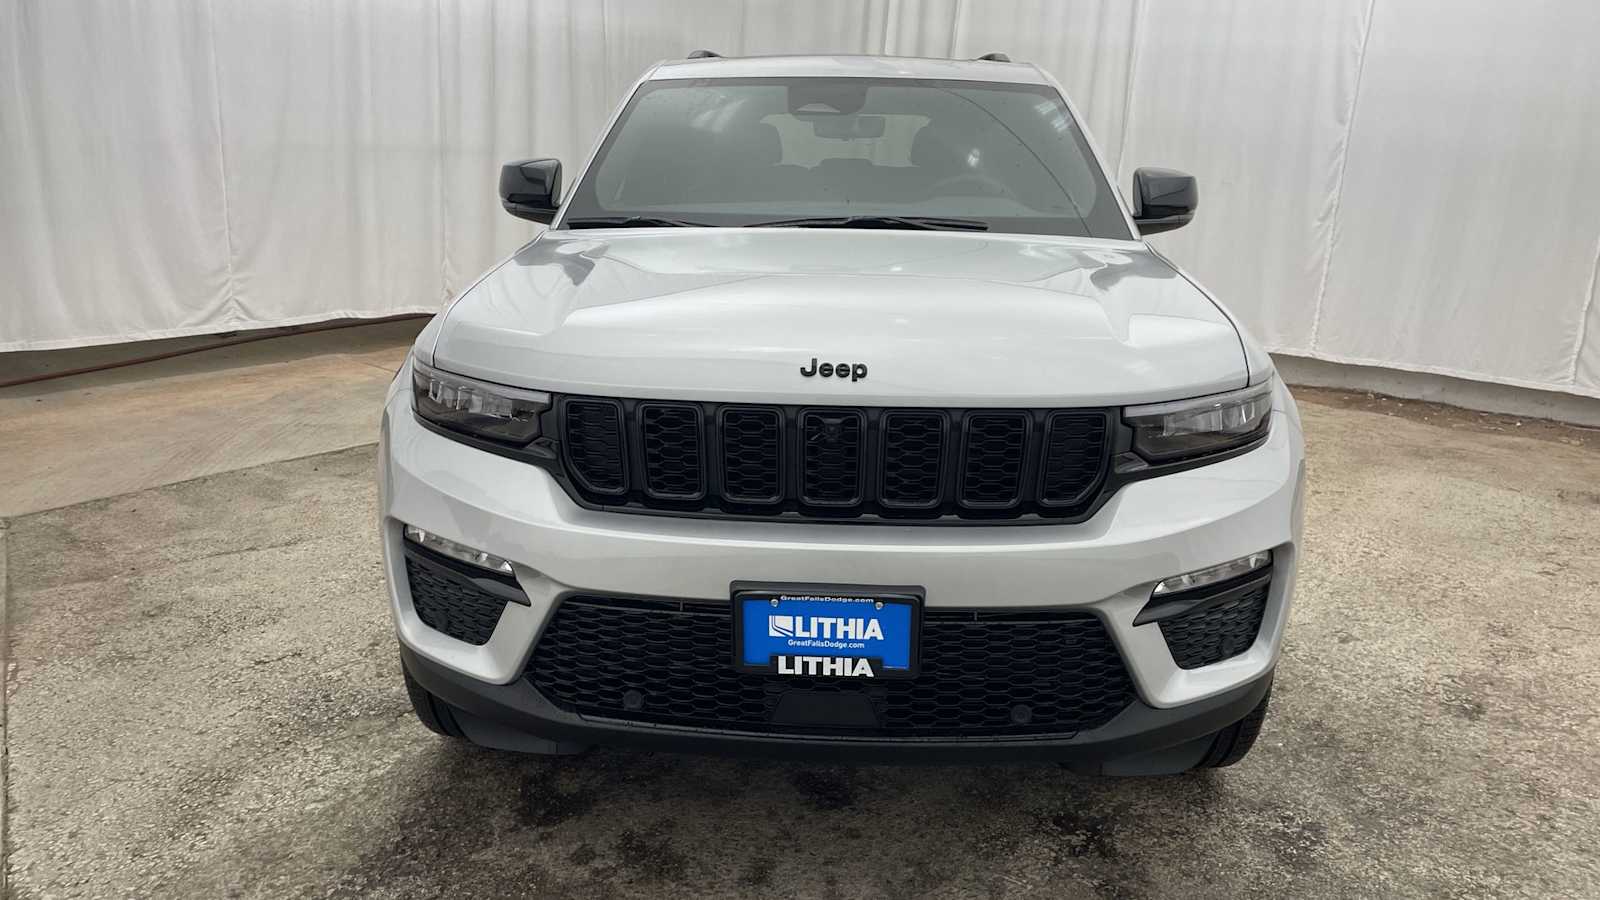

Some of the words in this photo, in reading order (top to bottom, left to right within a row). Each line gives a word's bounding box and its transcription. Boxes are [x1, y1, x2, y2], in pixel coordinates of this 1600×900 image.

[800, 358, 868, 382] Jeep
[780, 595, 874, 603] GreatFallsDodge.com
[795, 616, 884, 640] LITHIA
[788, 639, 865, 649] GreatFallsDodge.com
[778, 655, 874, 677] LITHIA
